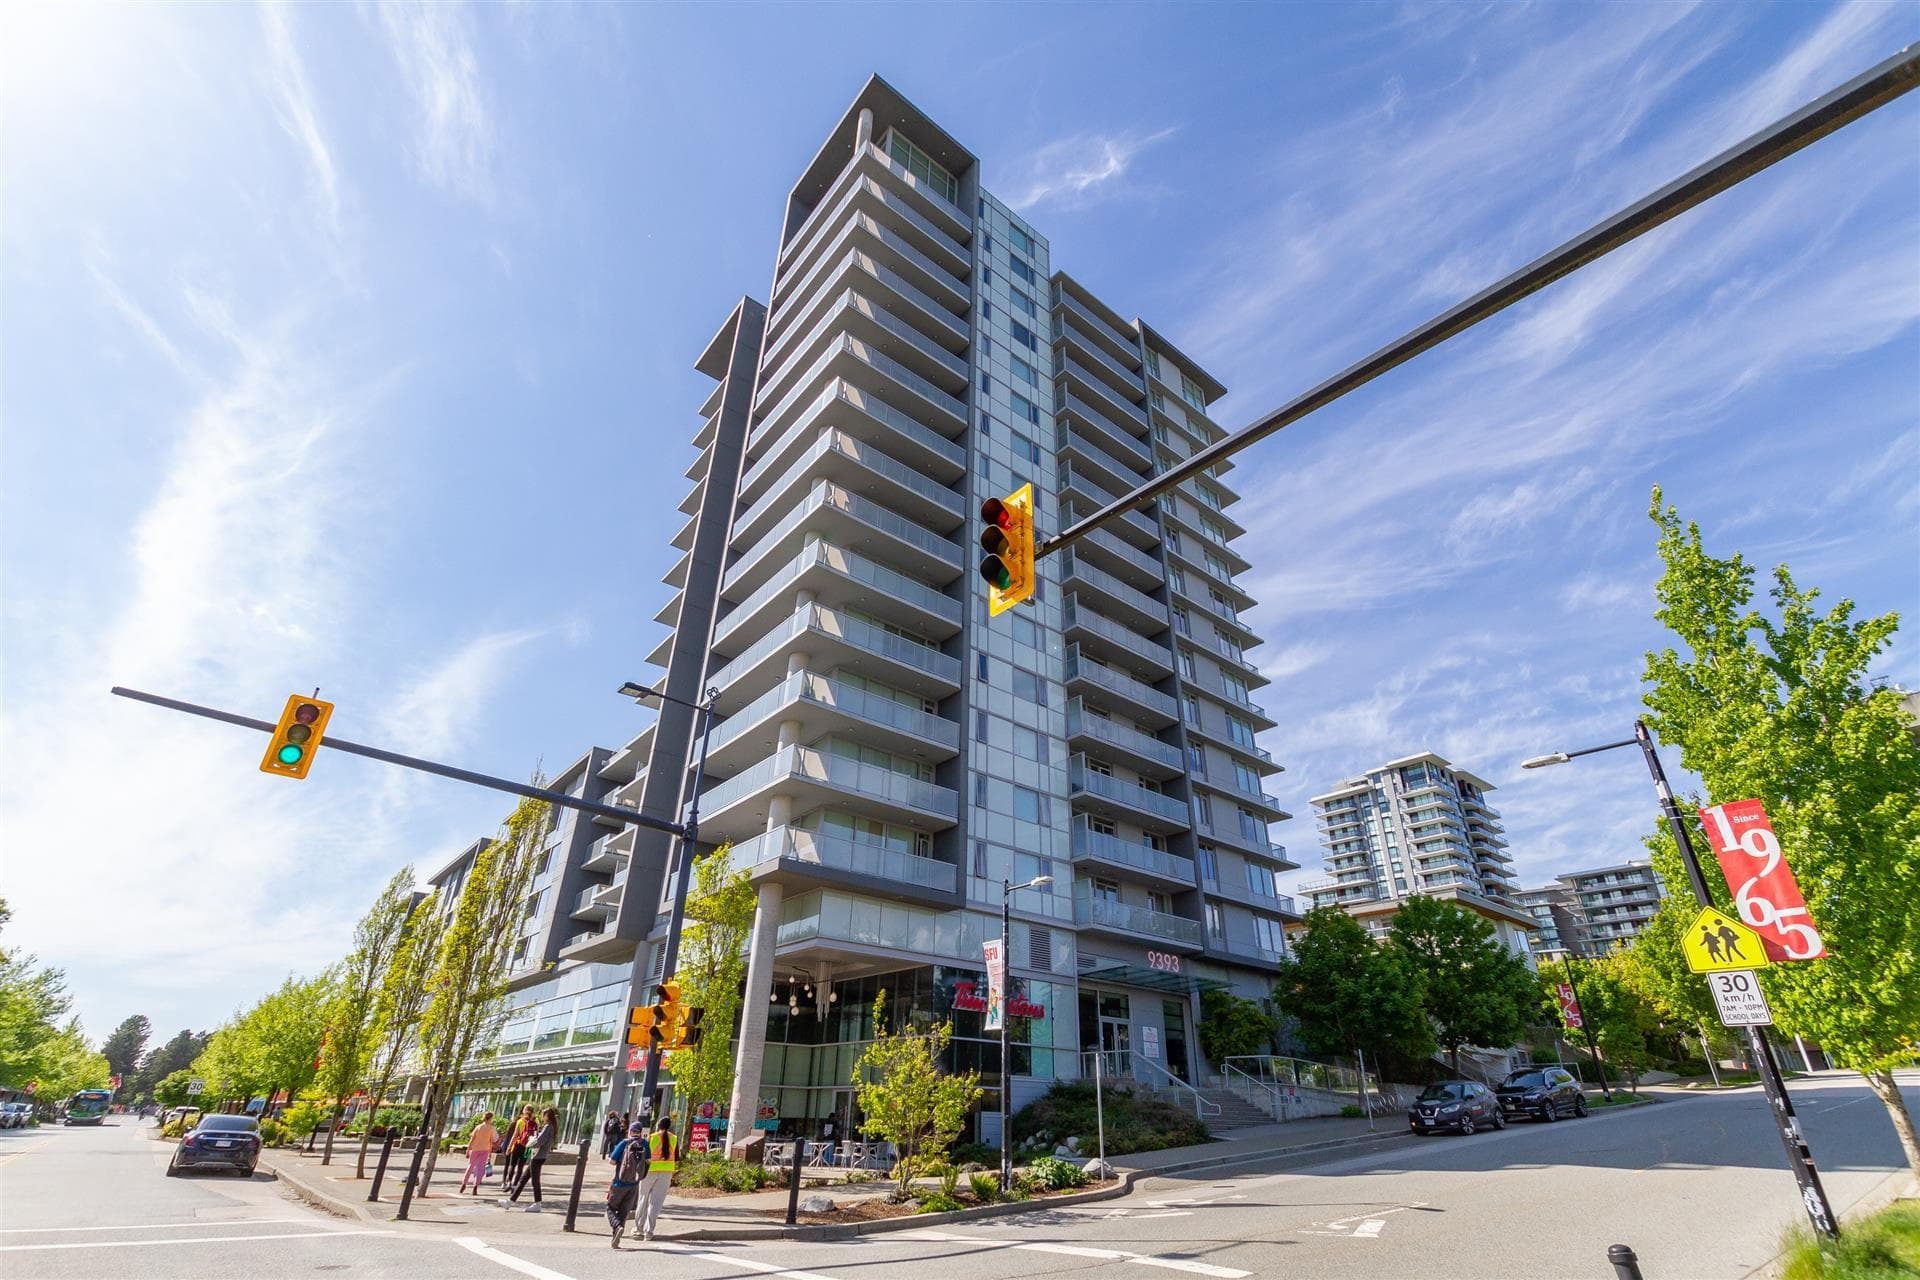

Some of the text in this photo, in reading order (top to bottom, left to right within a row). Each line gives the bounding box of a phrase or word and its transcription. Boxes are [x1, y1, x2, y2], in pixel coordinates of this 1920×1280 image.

[1733, 814, 1760, 824] Since
[1704, 805, 1823, 959] 1965
[984, 946, 998, 961] SFU
[1147, 951, 1180, 973] 9393
[1718, 974, 1749, 993] 30
[1722, 992, 1755, 1003] km/h
[190, 1082, 203, 1091] 30
